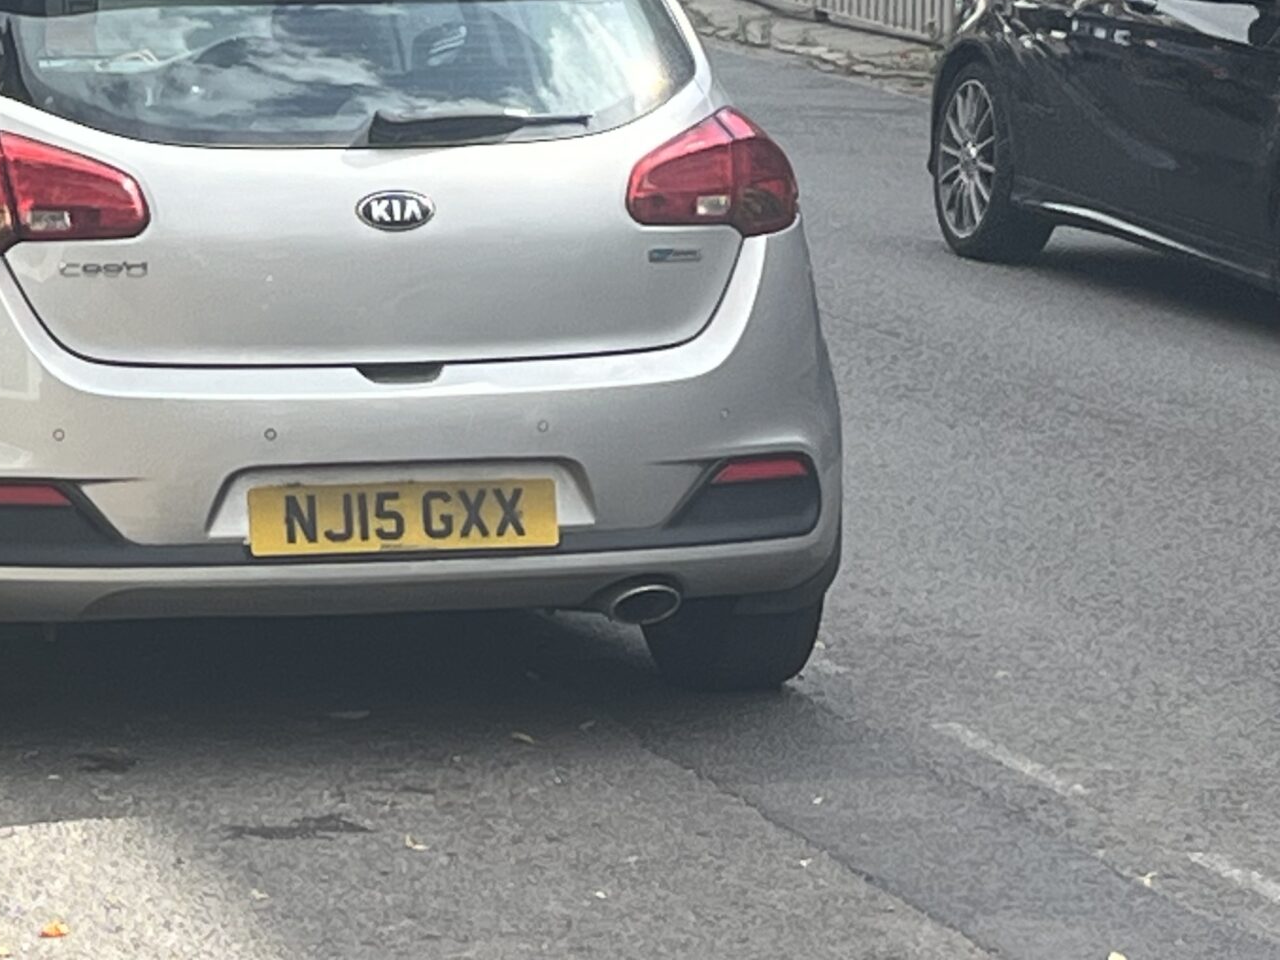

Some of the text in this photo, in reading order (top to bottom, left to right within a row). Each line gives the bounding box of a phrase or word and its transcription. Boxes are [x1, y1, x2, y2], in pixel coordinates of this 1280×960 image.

[370, 198, 423, 222] KIA
[284, 488, 526, 543] NJ15 GXX
